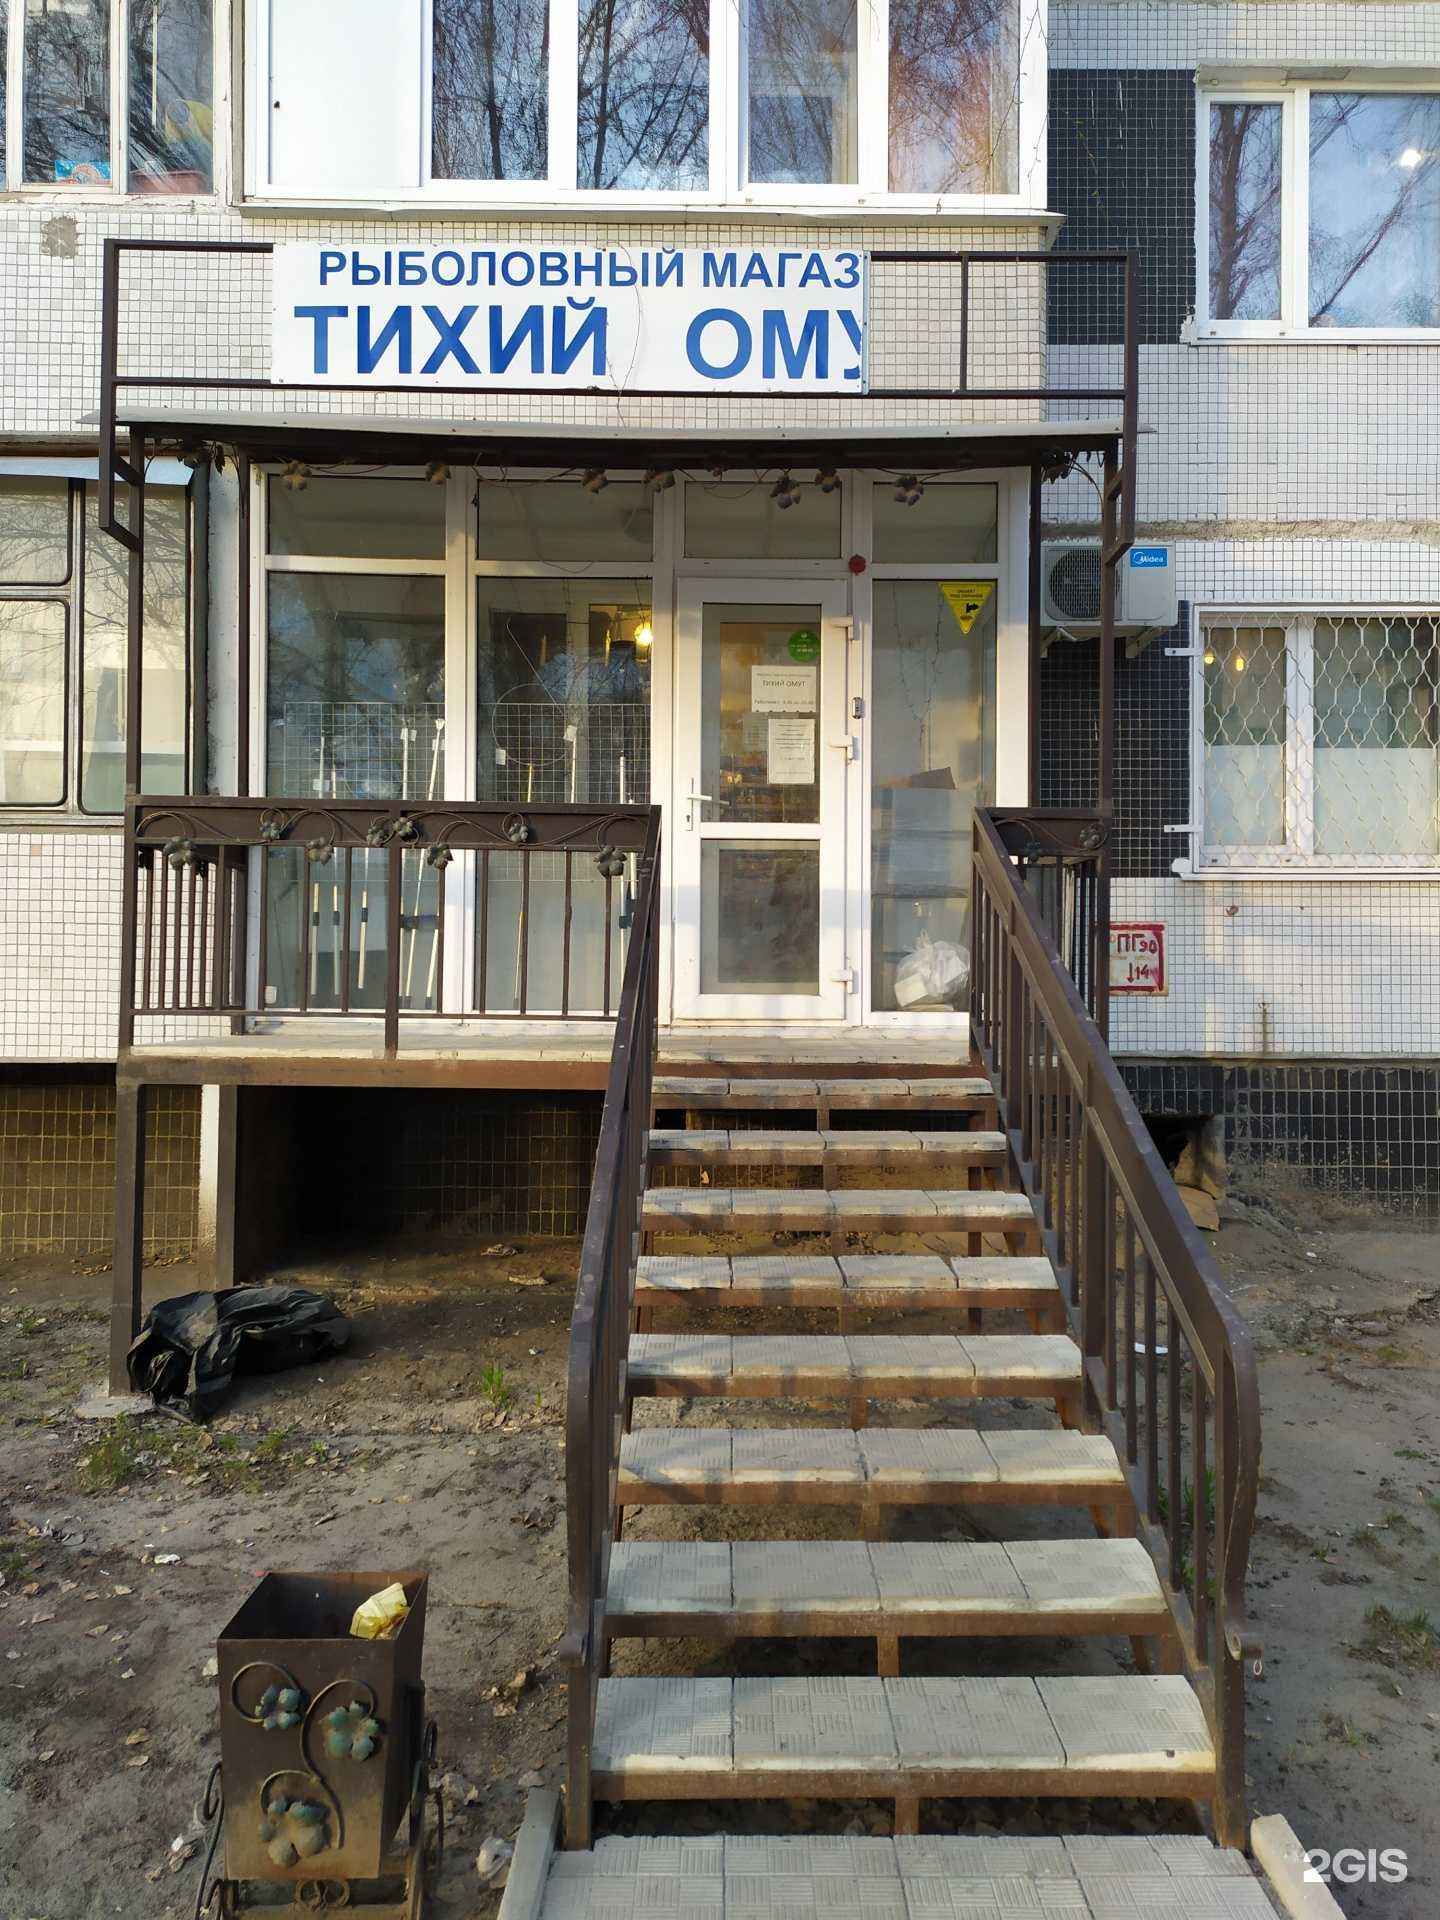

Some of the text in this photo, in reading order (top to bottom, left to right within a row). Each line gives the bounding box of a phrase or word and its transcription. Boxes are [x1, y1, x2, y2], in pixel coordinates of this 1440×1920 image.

[319, 246, 860, 289] РЫБОЛОВНЫЙ МАГАЗ
[294, 297, 608, 376] ТИХИЙ
